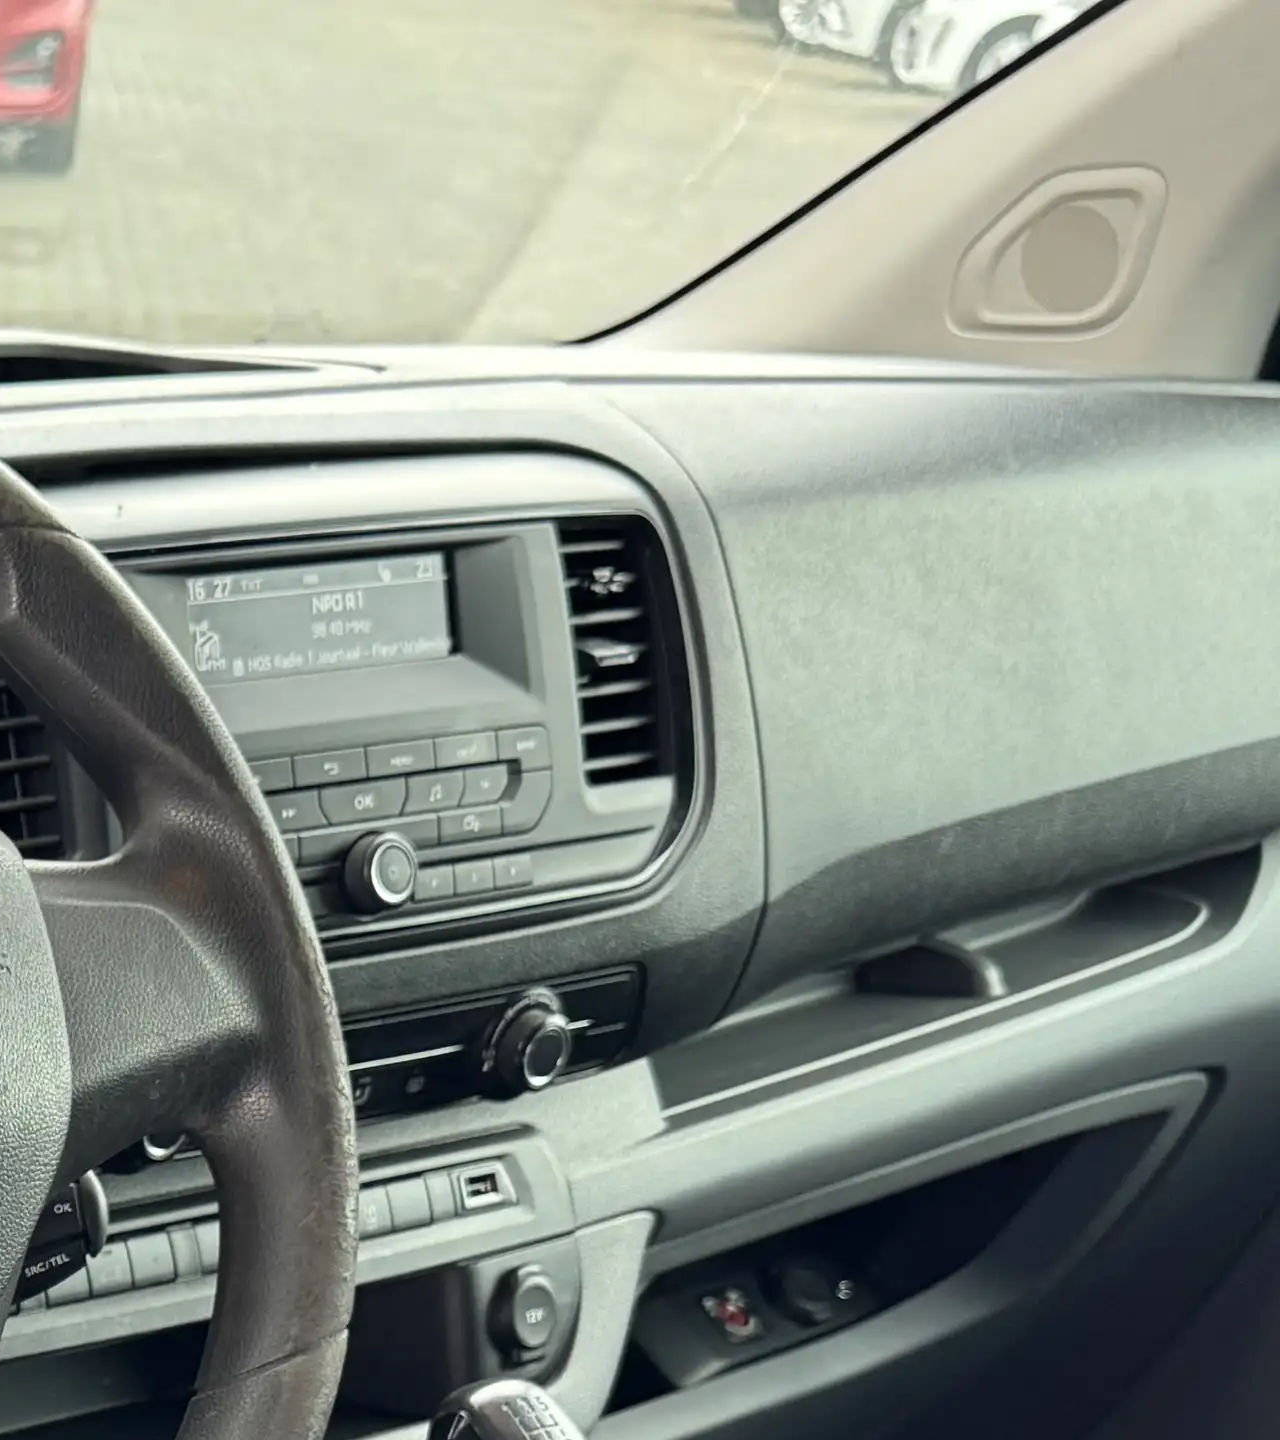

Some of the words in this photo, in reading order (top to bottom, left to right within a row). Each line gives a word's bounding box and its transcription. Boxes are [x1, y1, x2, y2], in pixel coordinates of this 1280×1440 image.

[354, 791, 375, 810] OK
[53, 1203, 73, 1214] OK
[24, 1252, 71, 1278] SRC/TEL
